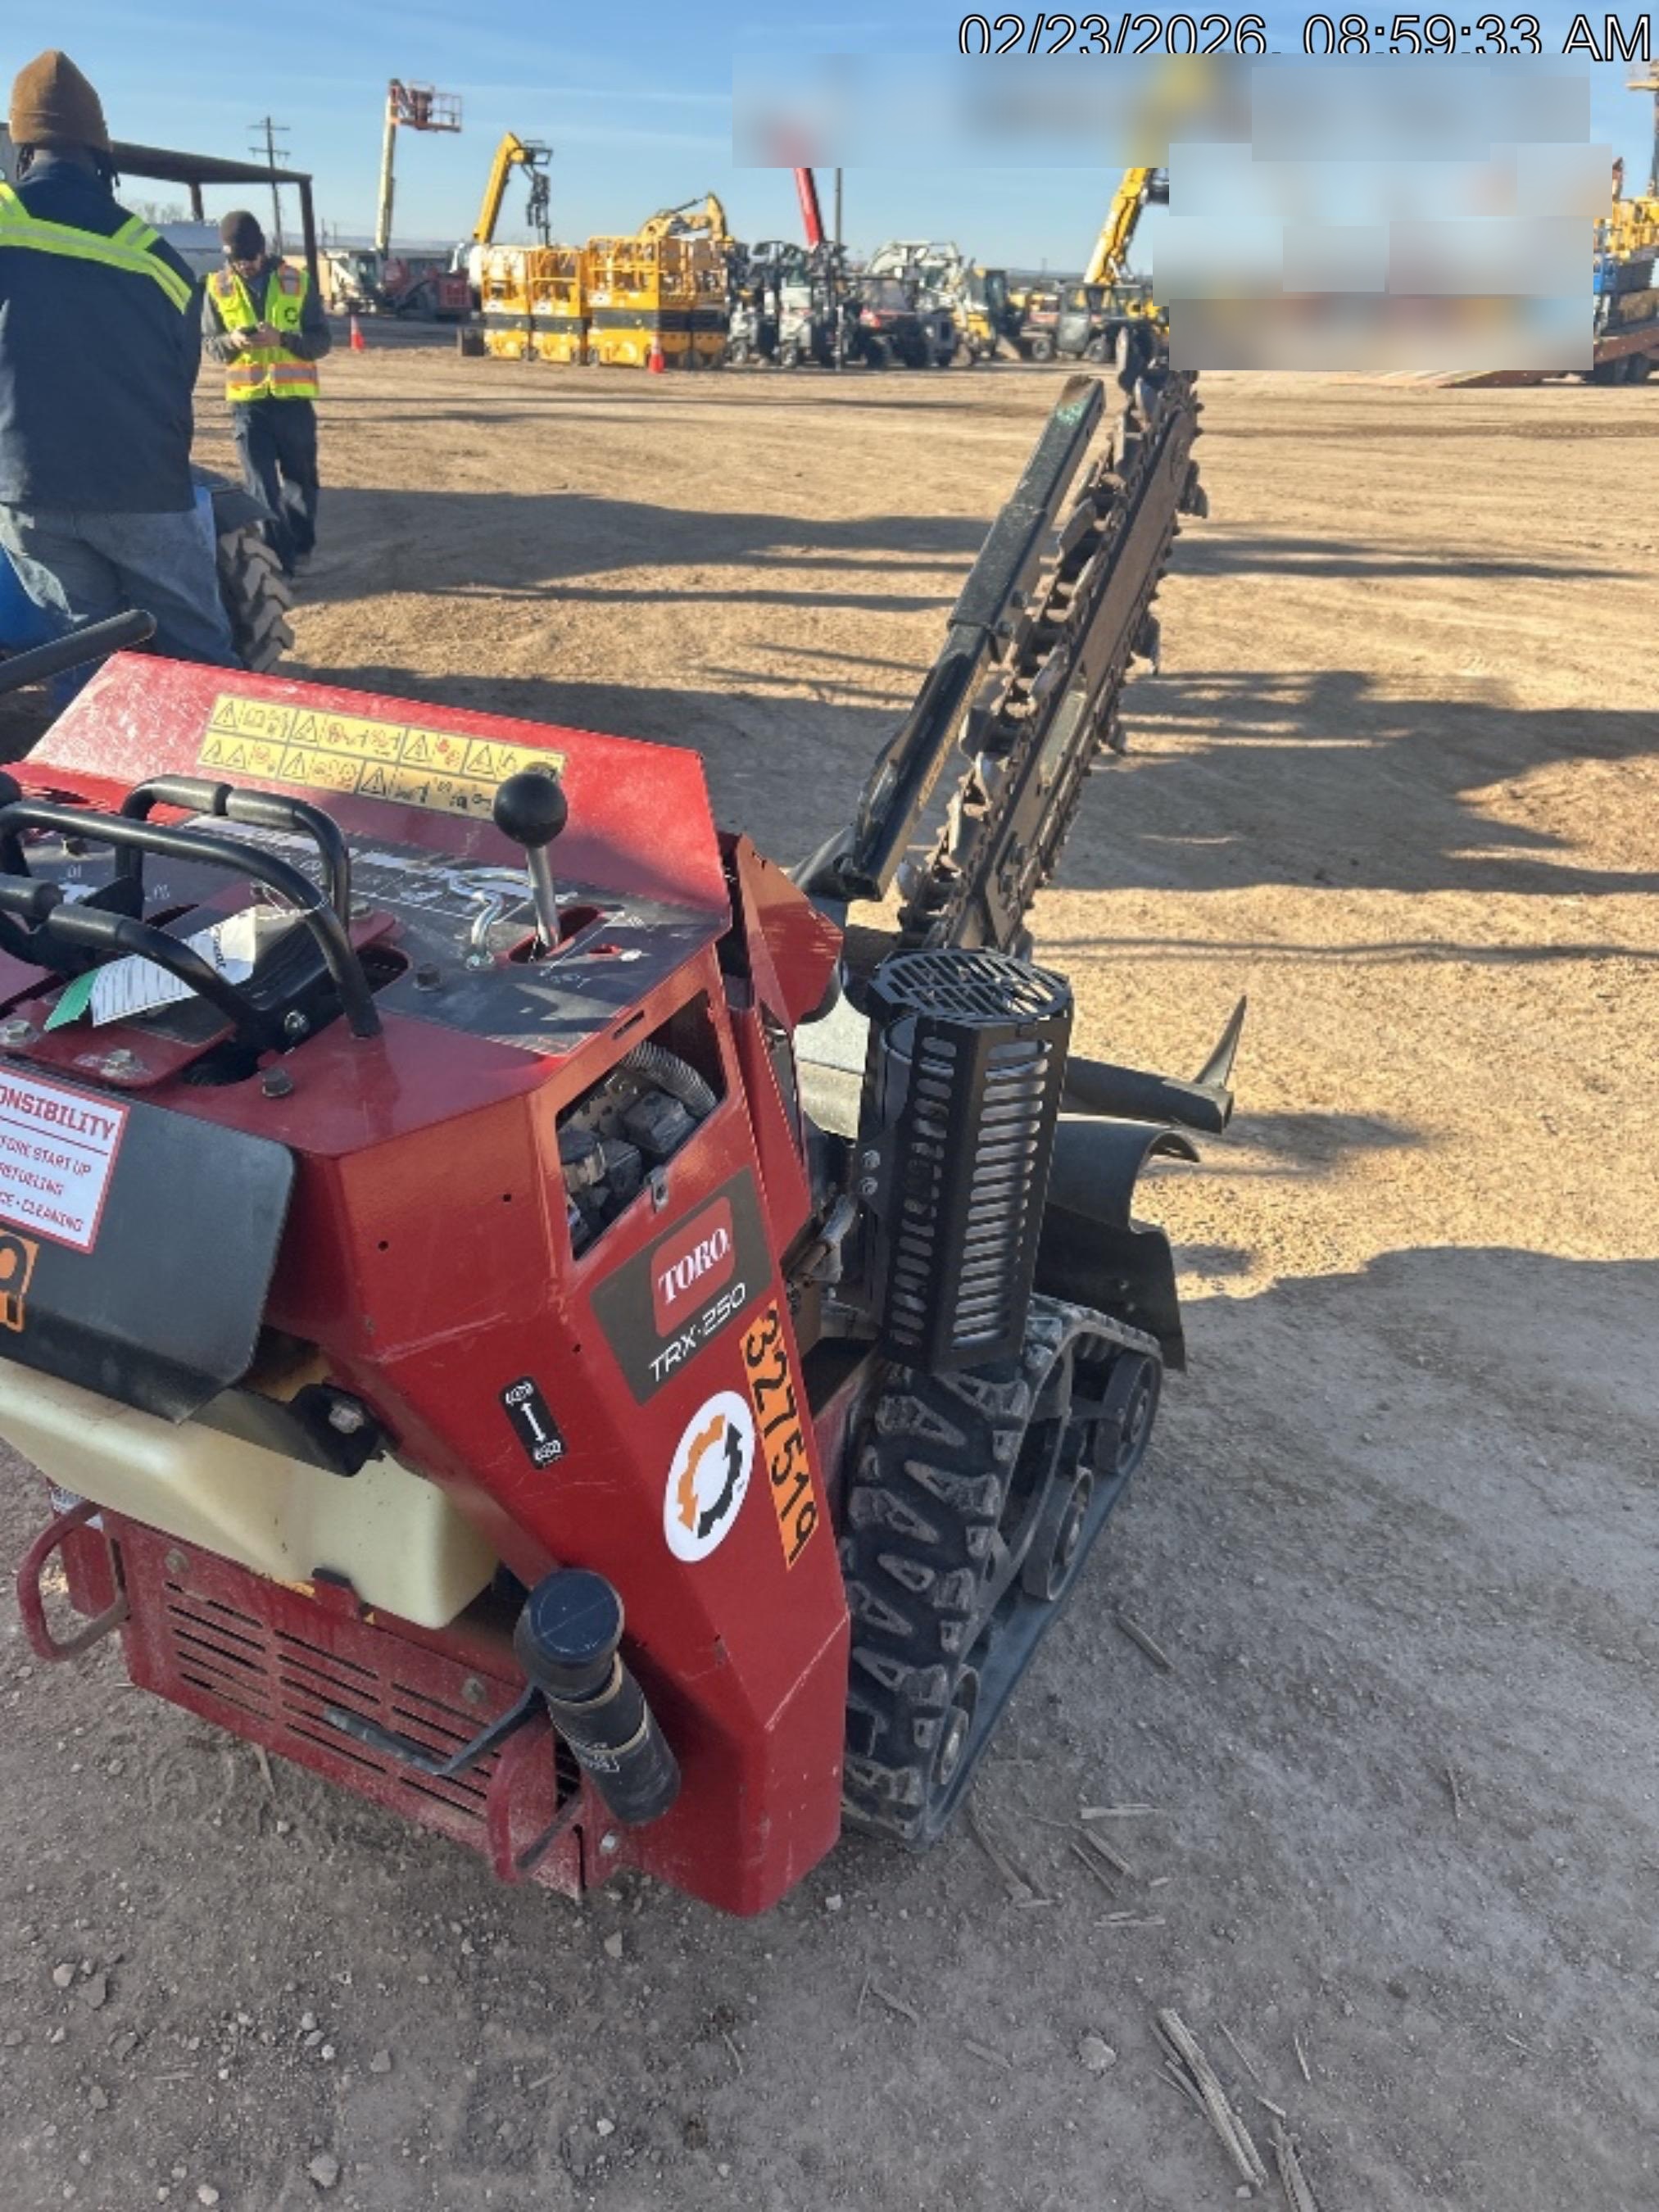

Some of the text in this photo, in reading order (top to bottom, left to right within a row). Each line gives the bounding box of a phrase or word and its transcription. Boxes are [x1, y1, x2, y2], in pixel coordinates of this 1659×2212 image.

[34, 1147, 72, 1171] START
[73, 1159, 92, 1177] UP
[21, 1199, 84, 1232] CLEANING
[658, 1228, 729, 1305] TORO
[747, 1308, 817, 1563] 327519
